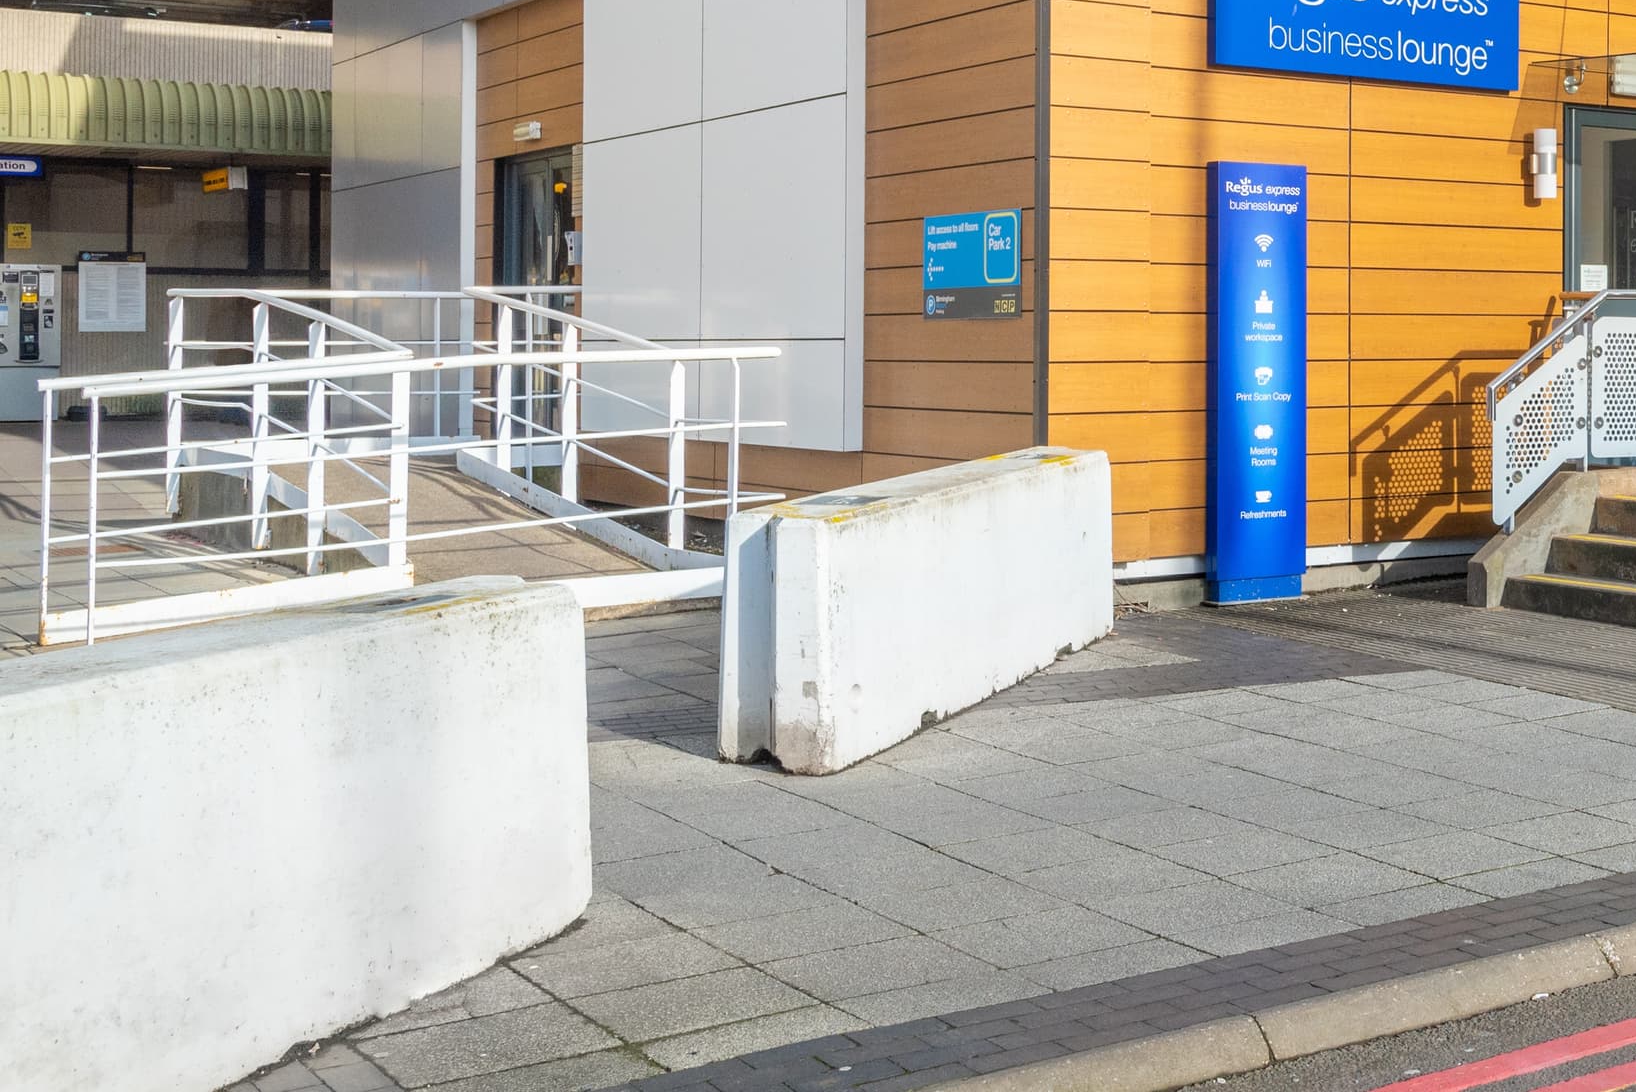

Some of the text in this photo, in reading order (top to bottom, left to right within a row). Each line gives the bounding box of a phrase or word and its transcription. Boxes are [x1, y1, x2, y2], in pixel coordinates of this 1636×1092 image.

[1225, 181, 1301, 197] Regus express
[988, 223, 1002, 236] Car
[988, 236, 1012, 251] Park 2
[1252, 321, 1276, 330] Private
[1245, 333, 1283, 343] workspace
[1236, 391, 1292, 402] Print Scan Copy
[1249, 446, 1278, 456] Meeting
[1251, 457, 1277, 466] Rooms
[1240, 509, 1287, 519] Refreshments
